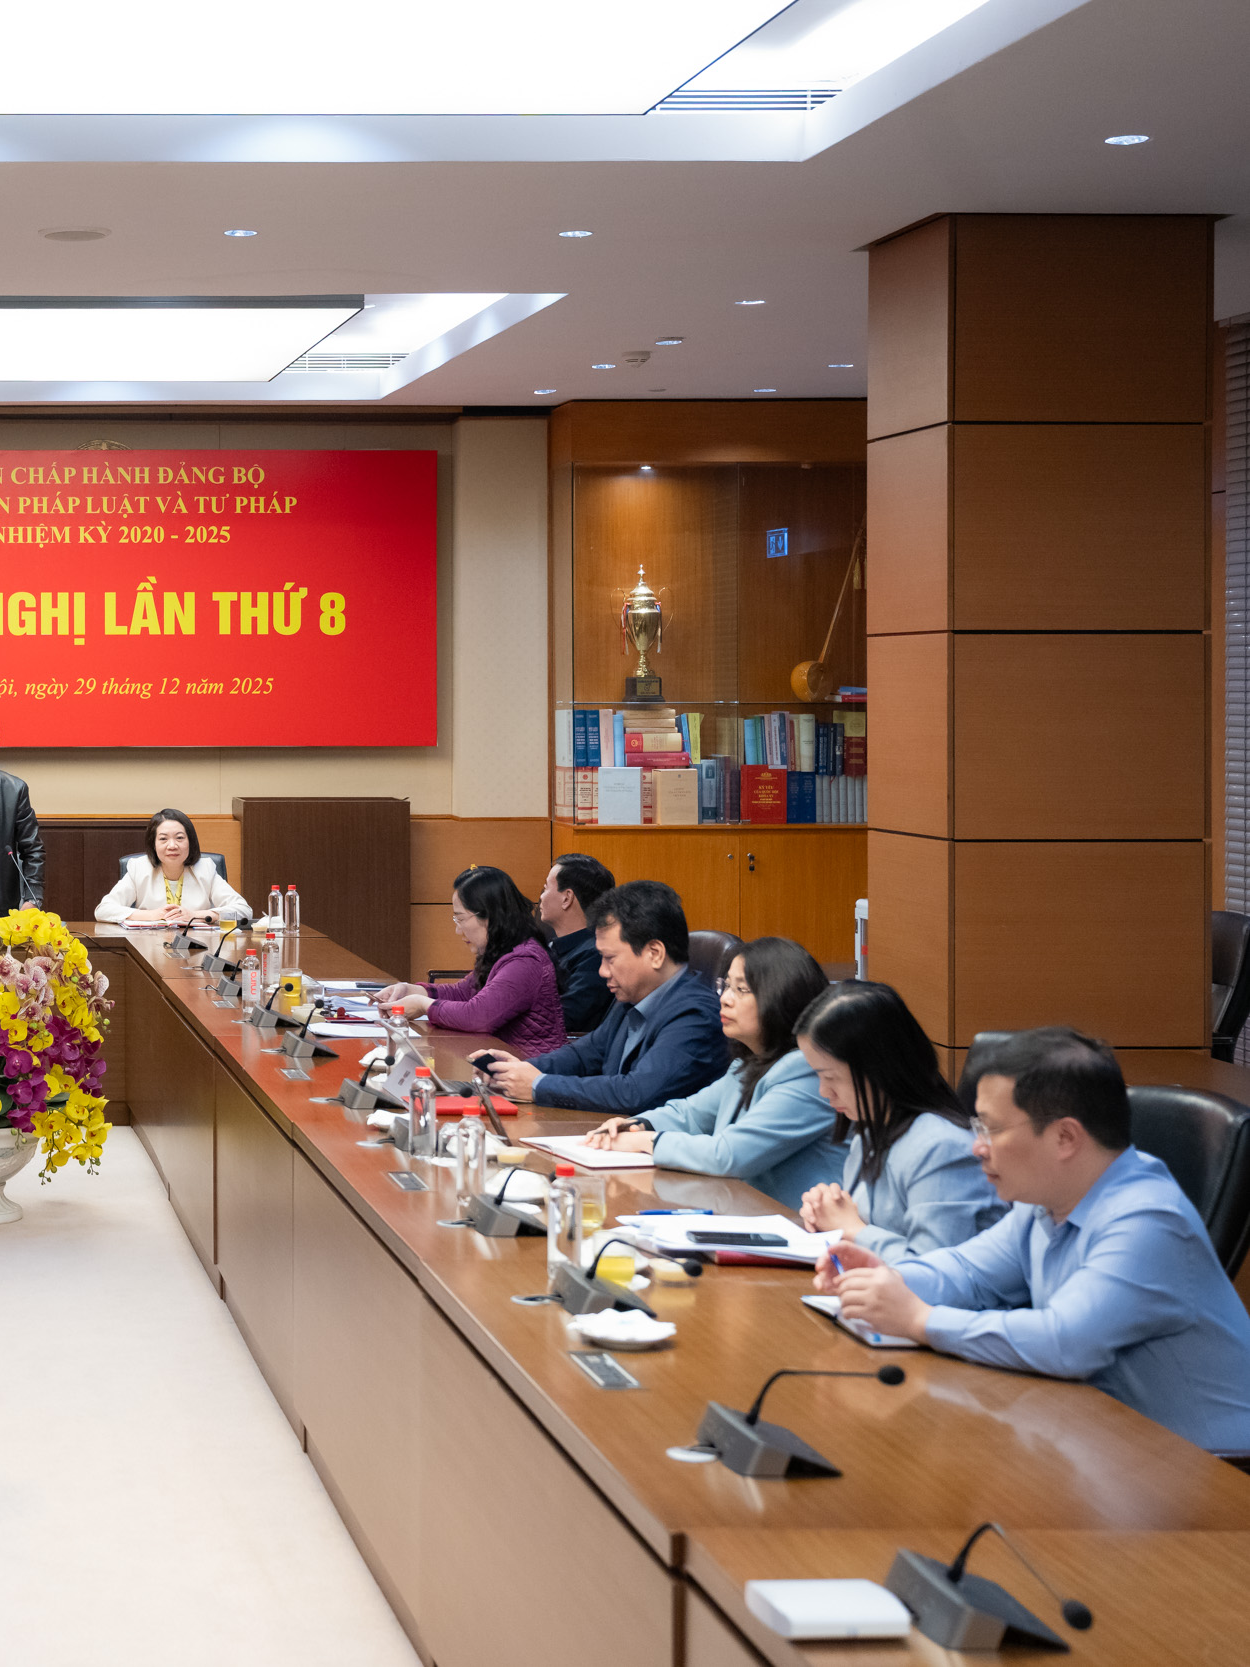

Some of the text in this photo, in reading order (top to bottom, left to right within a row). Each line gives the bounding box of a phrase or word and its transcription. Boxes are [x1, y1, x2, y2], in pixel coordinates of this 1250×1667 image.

[10, 461, 77, 485] CHẤP
[82, 461, 150, 485] HÀNH
[157, 461, 226, 485] ĐẢNG
[232, 464, 265, 489] BỘ
[17, 491, 81, 514] PHÁP
[85, 493, 150, 519] LUẬT
[155, 491, 189, 514] VÀ
[194, 493, 230, 514] TƯ
[234, 491, 298, 514] PHÁP
[78, 520, 113, 544] KỲ
[118, 525, 165, 544] 2020
[184, 525, 231, 544] 2025
[103, 575, 196, 636] LẦN
[211, 582, 308, 636] THỨ
[318, 591, 346, 636] 8
[24, 677, 69, 700] ngày
[73, 677, 97, 695] 29
[101, 677, 153, 700] tháng
[159, 677, 181, 695] 12
[185, 677, 224, 695] năm
[229, 677, 274, 695] 2025
